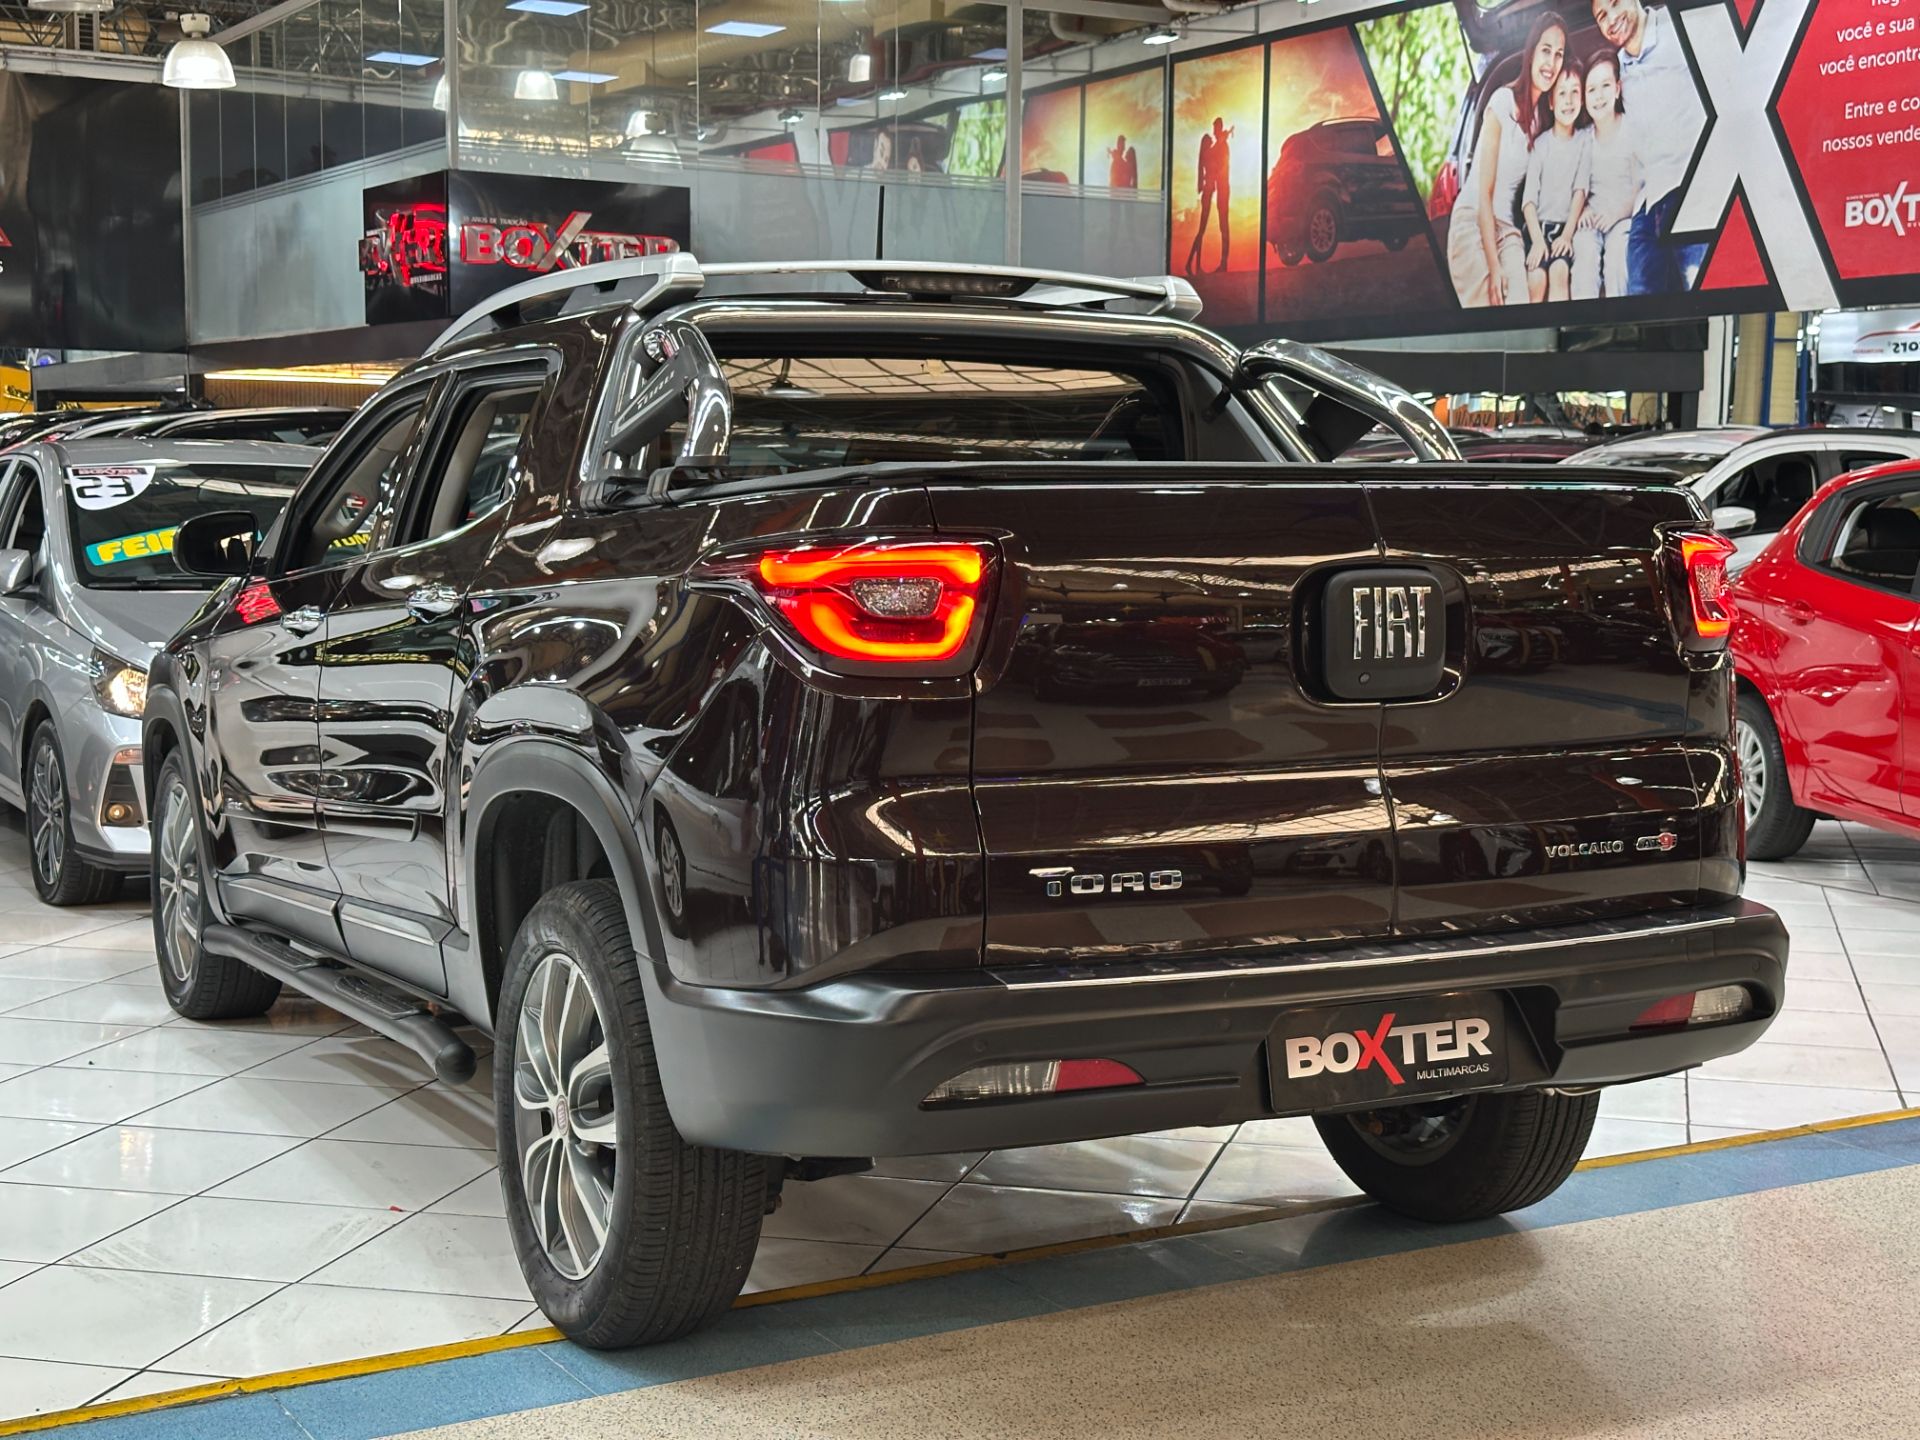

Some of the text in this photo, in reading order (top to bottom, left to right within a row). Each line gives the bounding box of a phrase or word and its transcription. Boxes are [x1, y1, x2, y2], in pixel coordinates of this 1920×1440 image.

[1836, 17, 1915, 43] você e sua
[1820, 46, 1920, 76] você encontr
[1845, 101, 1883, 119] Entre
[1887, 100, 1897, 113] e
[1823, 124, 1920, 152] nossos vende
[1352, 586, 1432, 660] FIAT
[1545, 840, 1625, 858] VOLCANO
[1028, 866, 1183, 897] TORO
[1285, 1013, 1493, 1085] BOXTER
[1416, 1063, 1490, 1081] MULTIMARCAS
